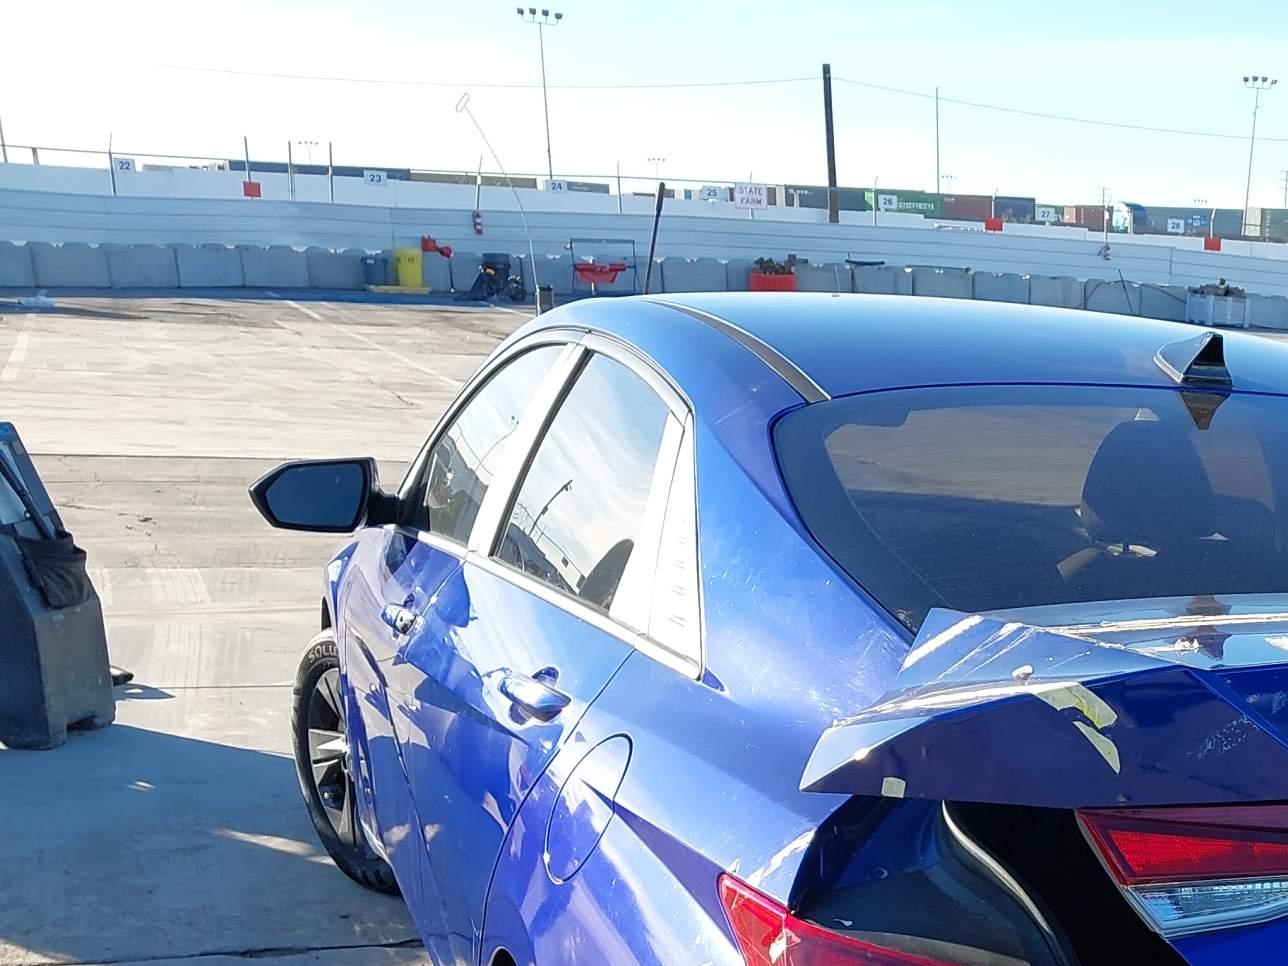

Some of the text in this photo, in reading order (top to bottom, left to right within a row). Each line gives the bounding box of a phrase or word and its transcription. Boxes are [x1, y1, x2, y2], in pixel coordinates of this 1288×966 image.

[119, 161, 131, 170] 22
[369, 174, 382, 183] 23
[551, 182, 562, 191] 24
[739, 186, 763, 196] STATE
[706, 188, 718, 197] 25
[740, 196, 762, 206] FARM
[1041, 210, 1051, 218] 27
